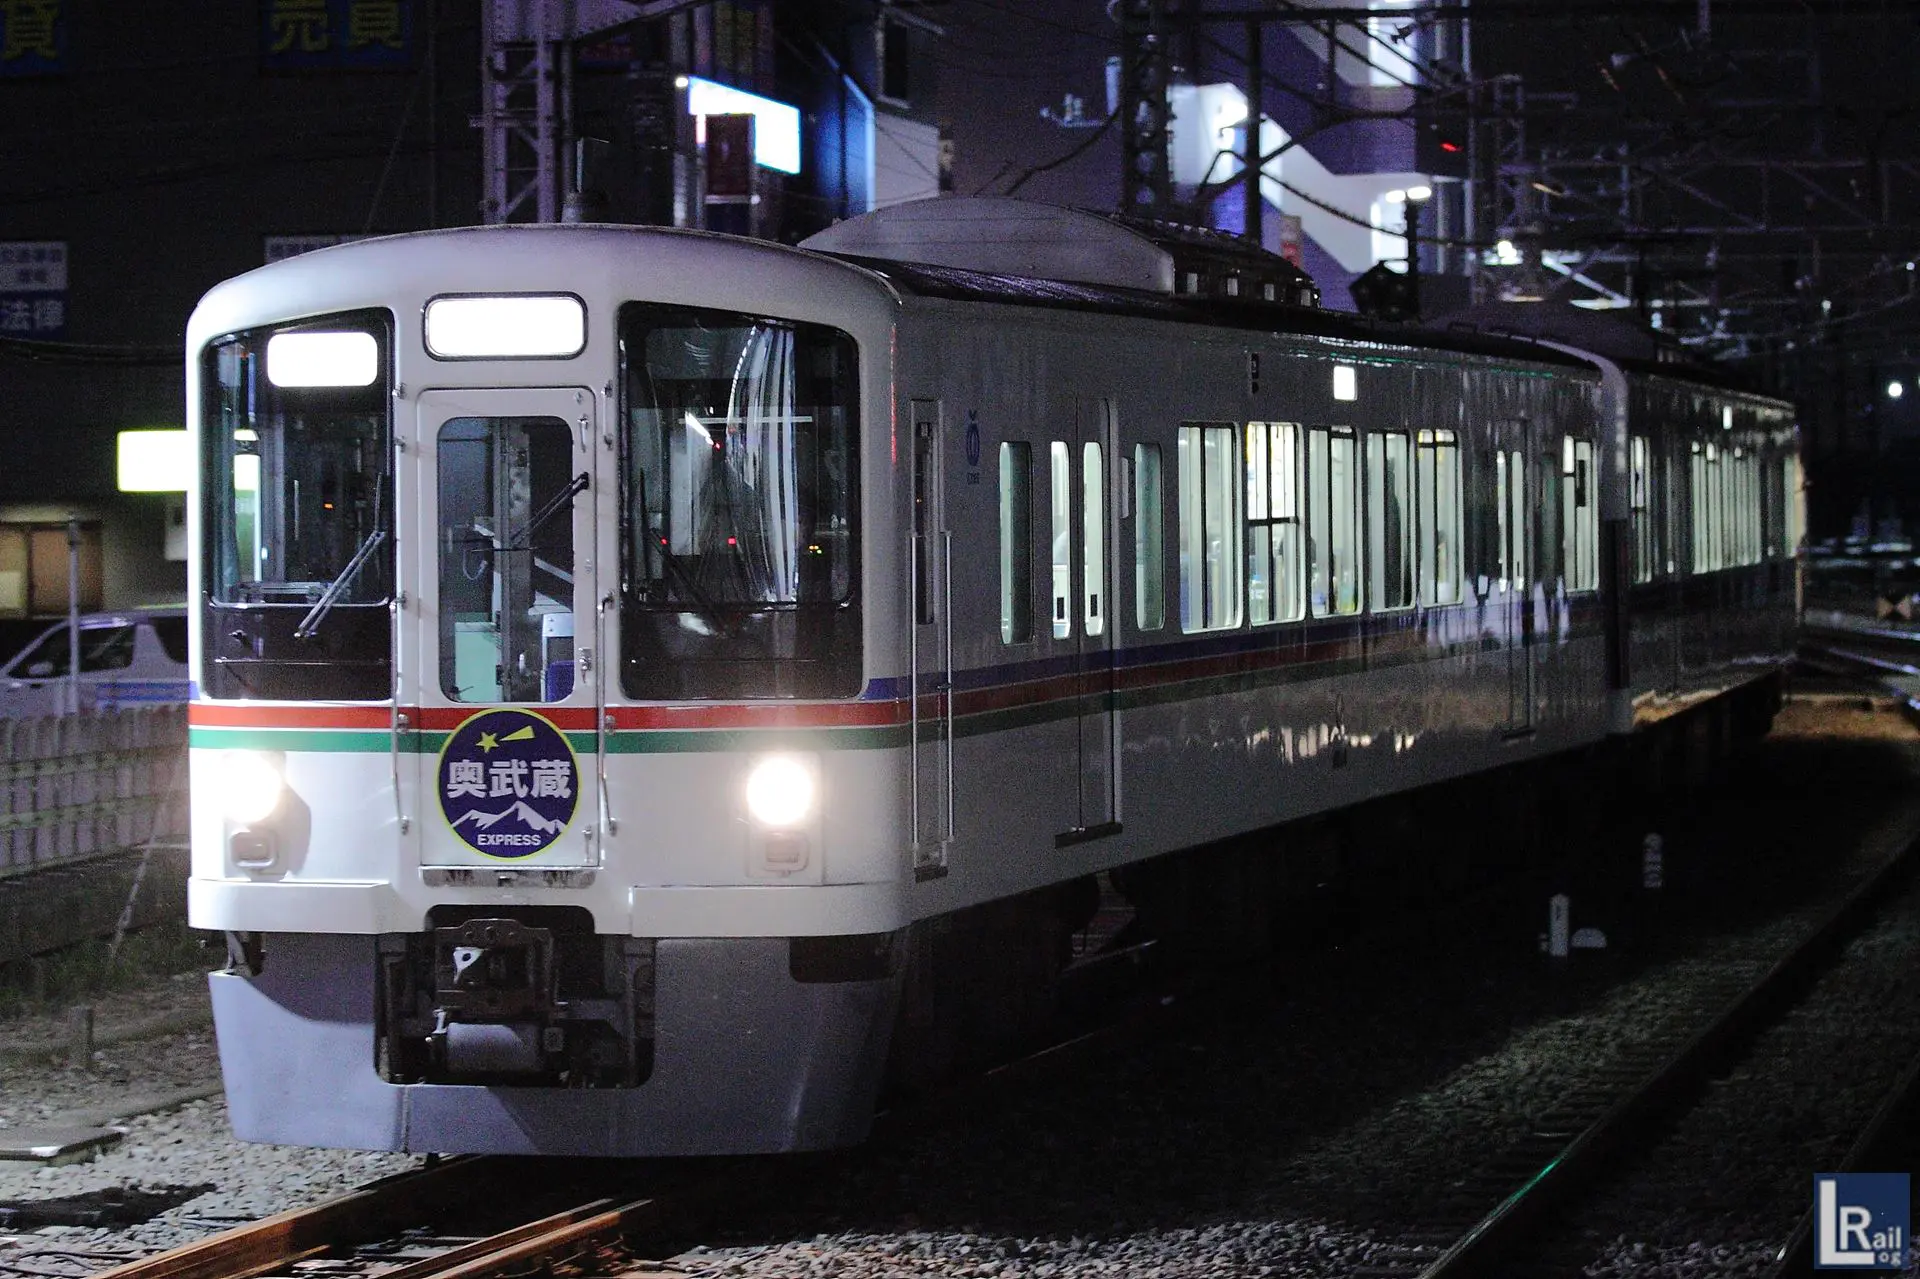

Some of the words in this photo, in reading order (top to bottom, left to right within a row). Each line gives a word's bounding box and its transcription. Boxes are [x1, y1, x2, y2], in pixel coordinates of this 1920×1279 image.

[446, 759, 571, 799] 奥武蔵
[478, 834, 541, 846] EXPRESS
